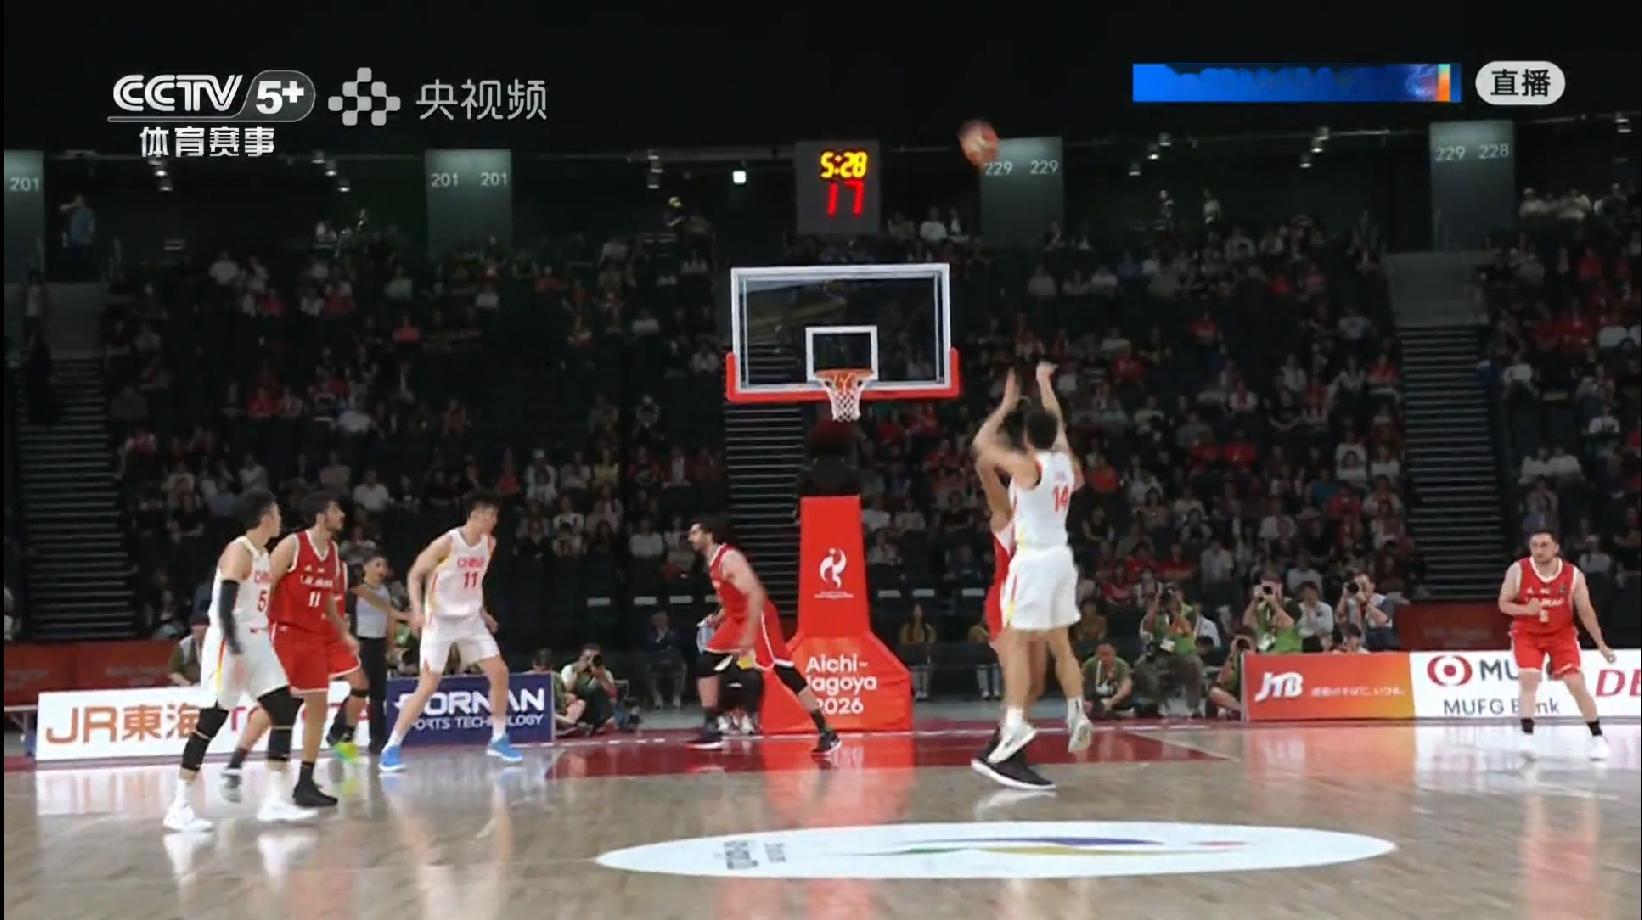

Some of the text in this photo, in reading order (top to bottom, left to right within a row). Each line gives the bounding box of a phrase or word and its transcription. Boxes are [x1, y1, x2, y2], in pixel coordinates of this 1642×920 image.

[1435, 144, 1510, 162] 229 228
[819, 151, 868, 179] 5:28
[984, 159, 1059, 176] 229 229
[9, 175, 40, 192] 201
[431, 170, 508, 188] 201 201
[826, 179, 865, 217] 17
[1053, 485, 1070, 512] 14
[464, 571, 478, 588] 11
[309, 591, 321, 608] 11
[806, 653, 868, 673] Aichi-
[1254, 671, 1304, 703] JTB
[1443, 697, 1560, 716] MUFG Bnk
[454, 713, 545, 730] TECHLOGY
